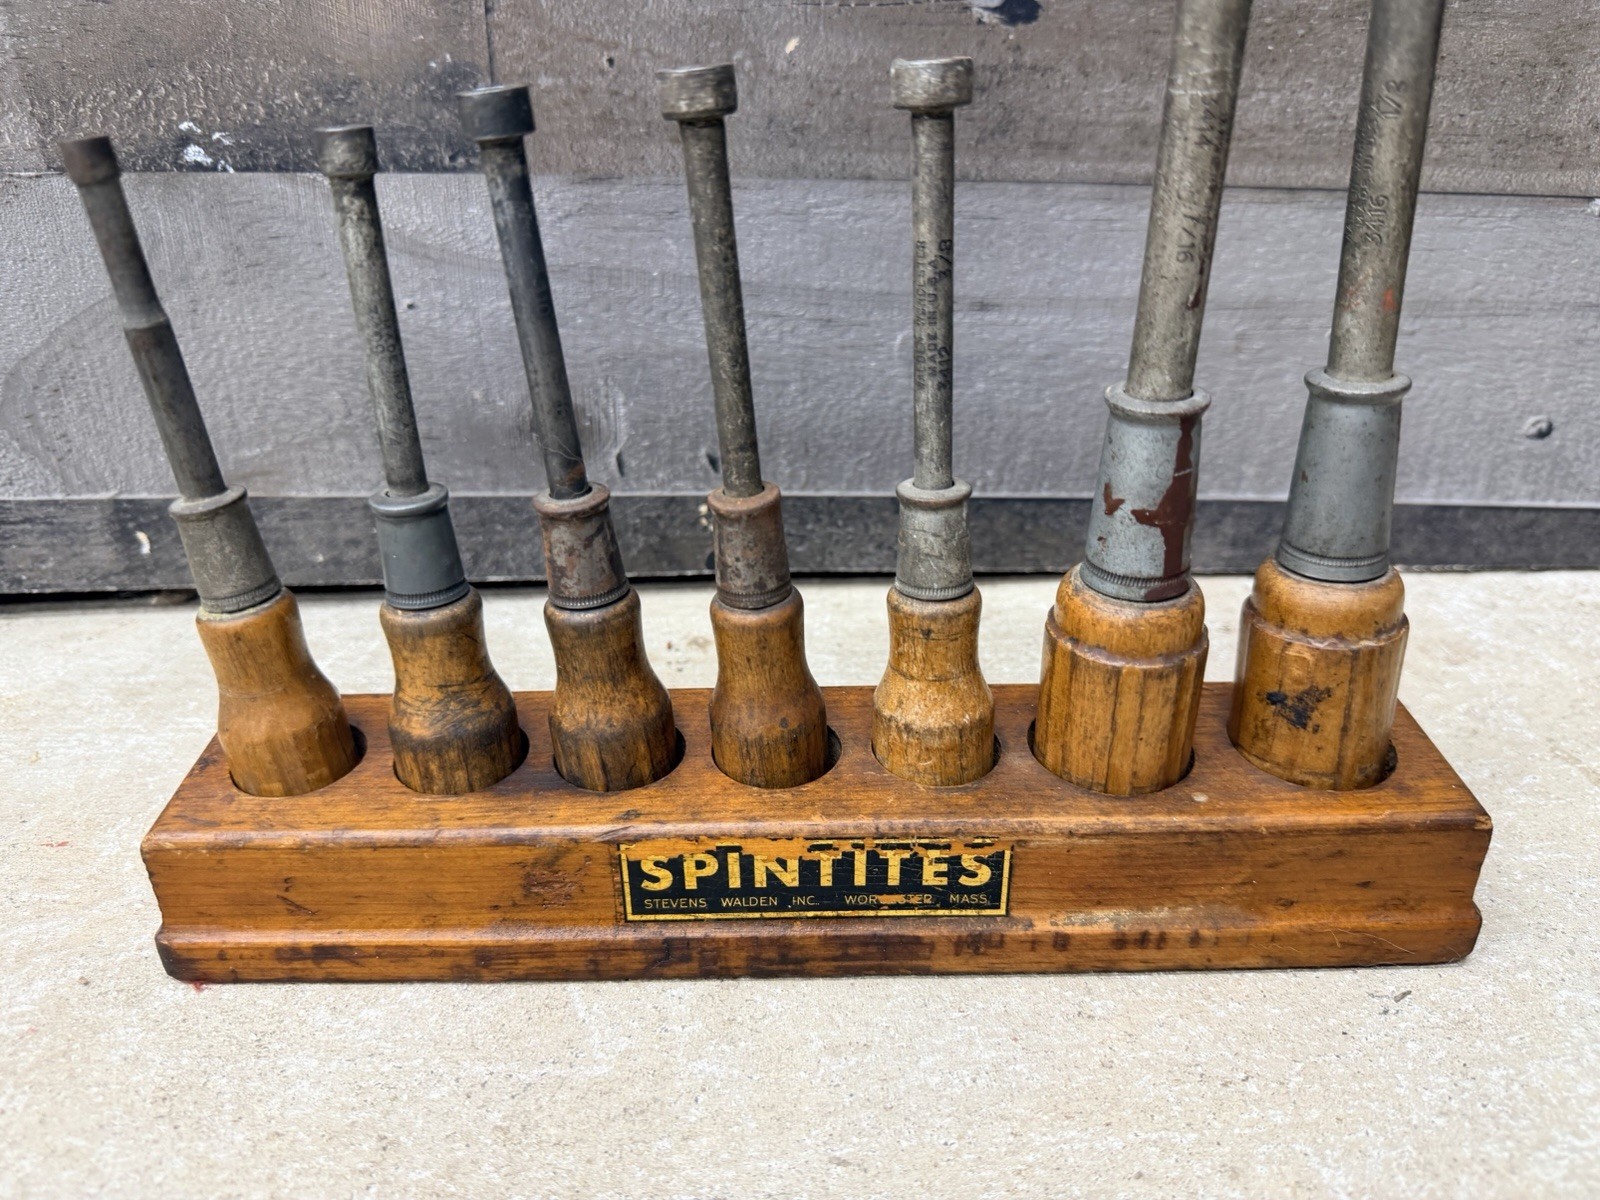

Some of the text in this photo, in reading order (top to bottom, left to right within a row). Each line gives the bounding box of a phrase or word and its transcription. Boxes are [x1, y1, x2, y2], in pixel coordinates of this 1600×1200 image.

[1363, 194, 1389, 245] 3416
[935, 238, 953, 281] 3/8
[927, 310, 938, 327] IN
[927, 332, 938, 378] MADE
[937, 346, 951, 391] 3412
[640, 849, 992, 891] SPINTITES
[644, 898, 707, 909] STEVENS
[721, 896, 778, 907] WALDEN
